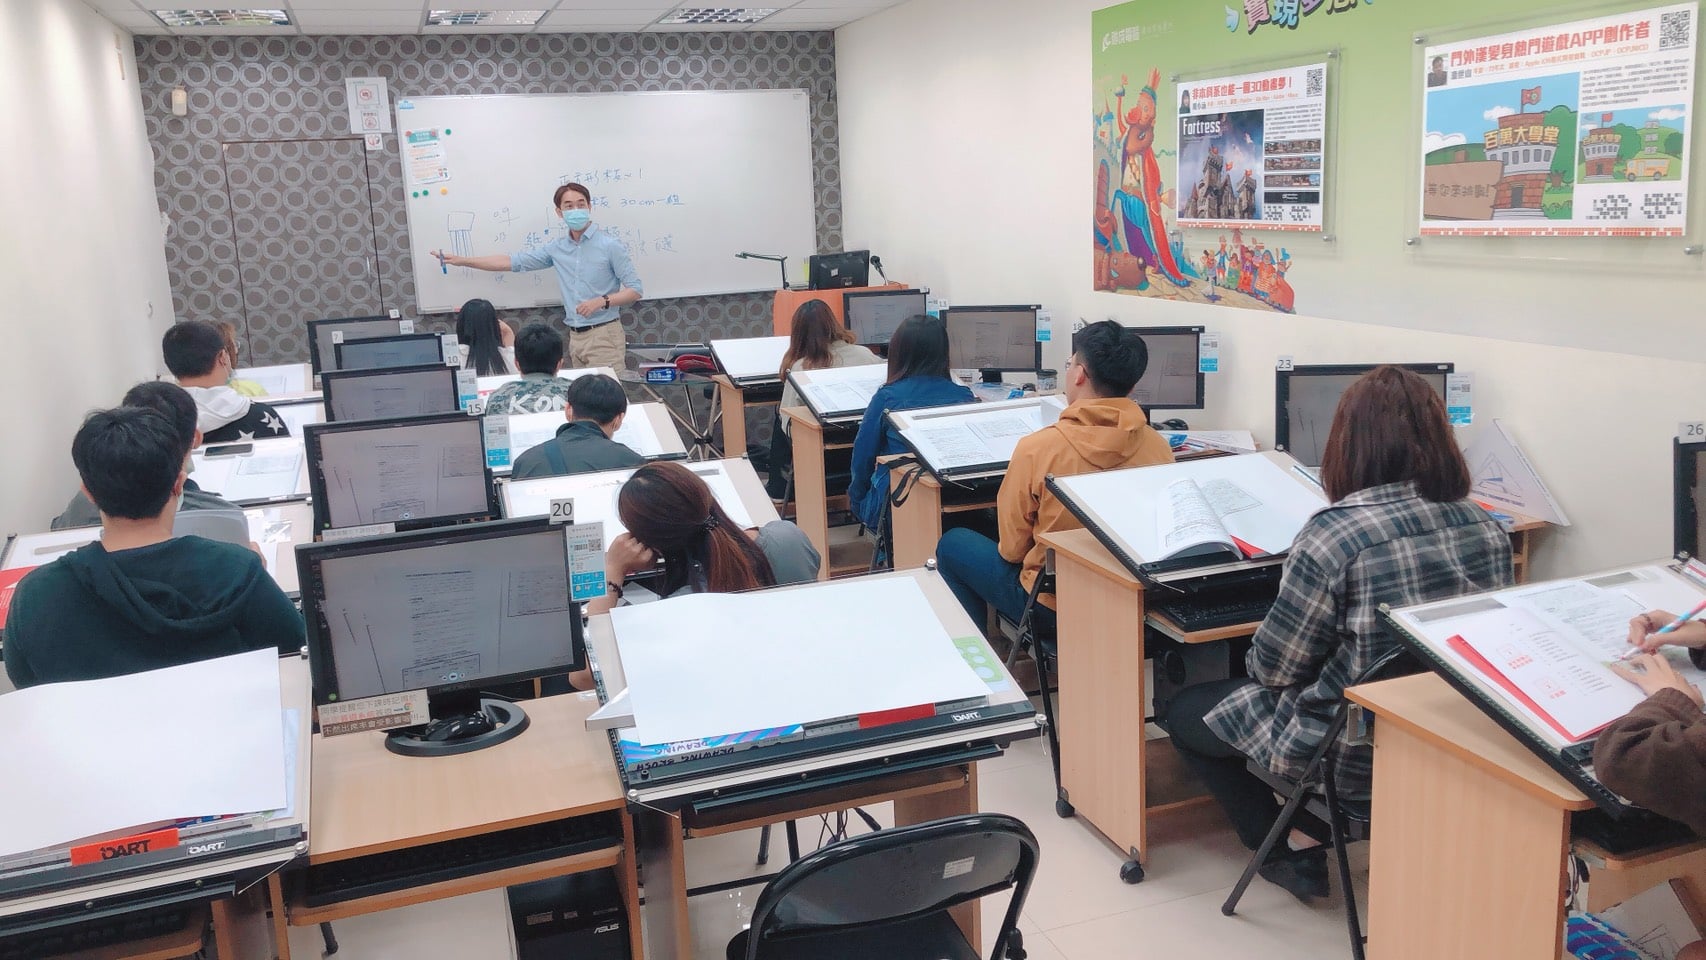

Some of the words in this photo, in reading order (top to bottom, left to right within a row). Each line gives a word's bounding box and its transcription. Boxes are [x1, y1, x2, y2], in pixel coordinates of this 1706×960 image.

[1243, 0, 1359, 34] 實現
[1450, 20, 1651, 67] 門外漢變身熱門遊戲APP創作者
[1183, 118, 1221, 136] Fortress
[1484, 126, 1560, 150] 百萬大學堂
[447, 355, 459, 364] 10
[1278, 359, 1292, 369] 23
[468, 403, 482, 414] 15
[1687, 423, 1704, 436] 26
[552, 501, 573, 517] 20
[681, 746, 735, 762] DRAWING
[100, 839, 152, 861] DART
[188, 841, 226, 854] DART
[593, 922, 620, 934] ASUS
